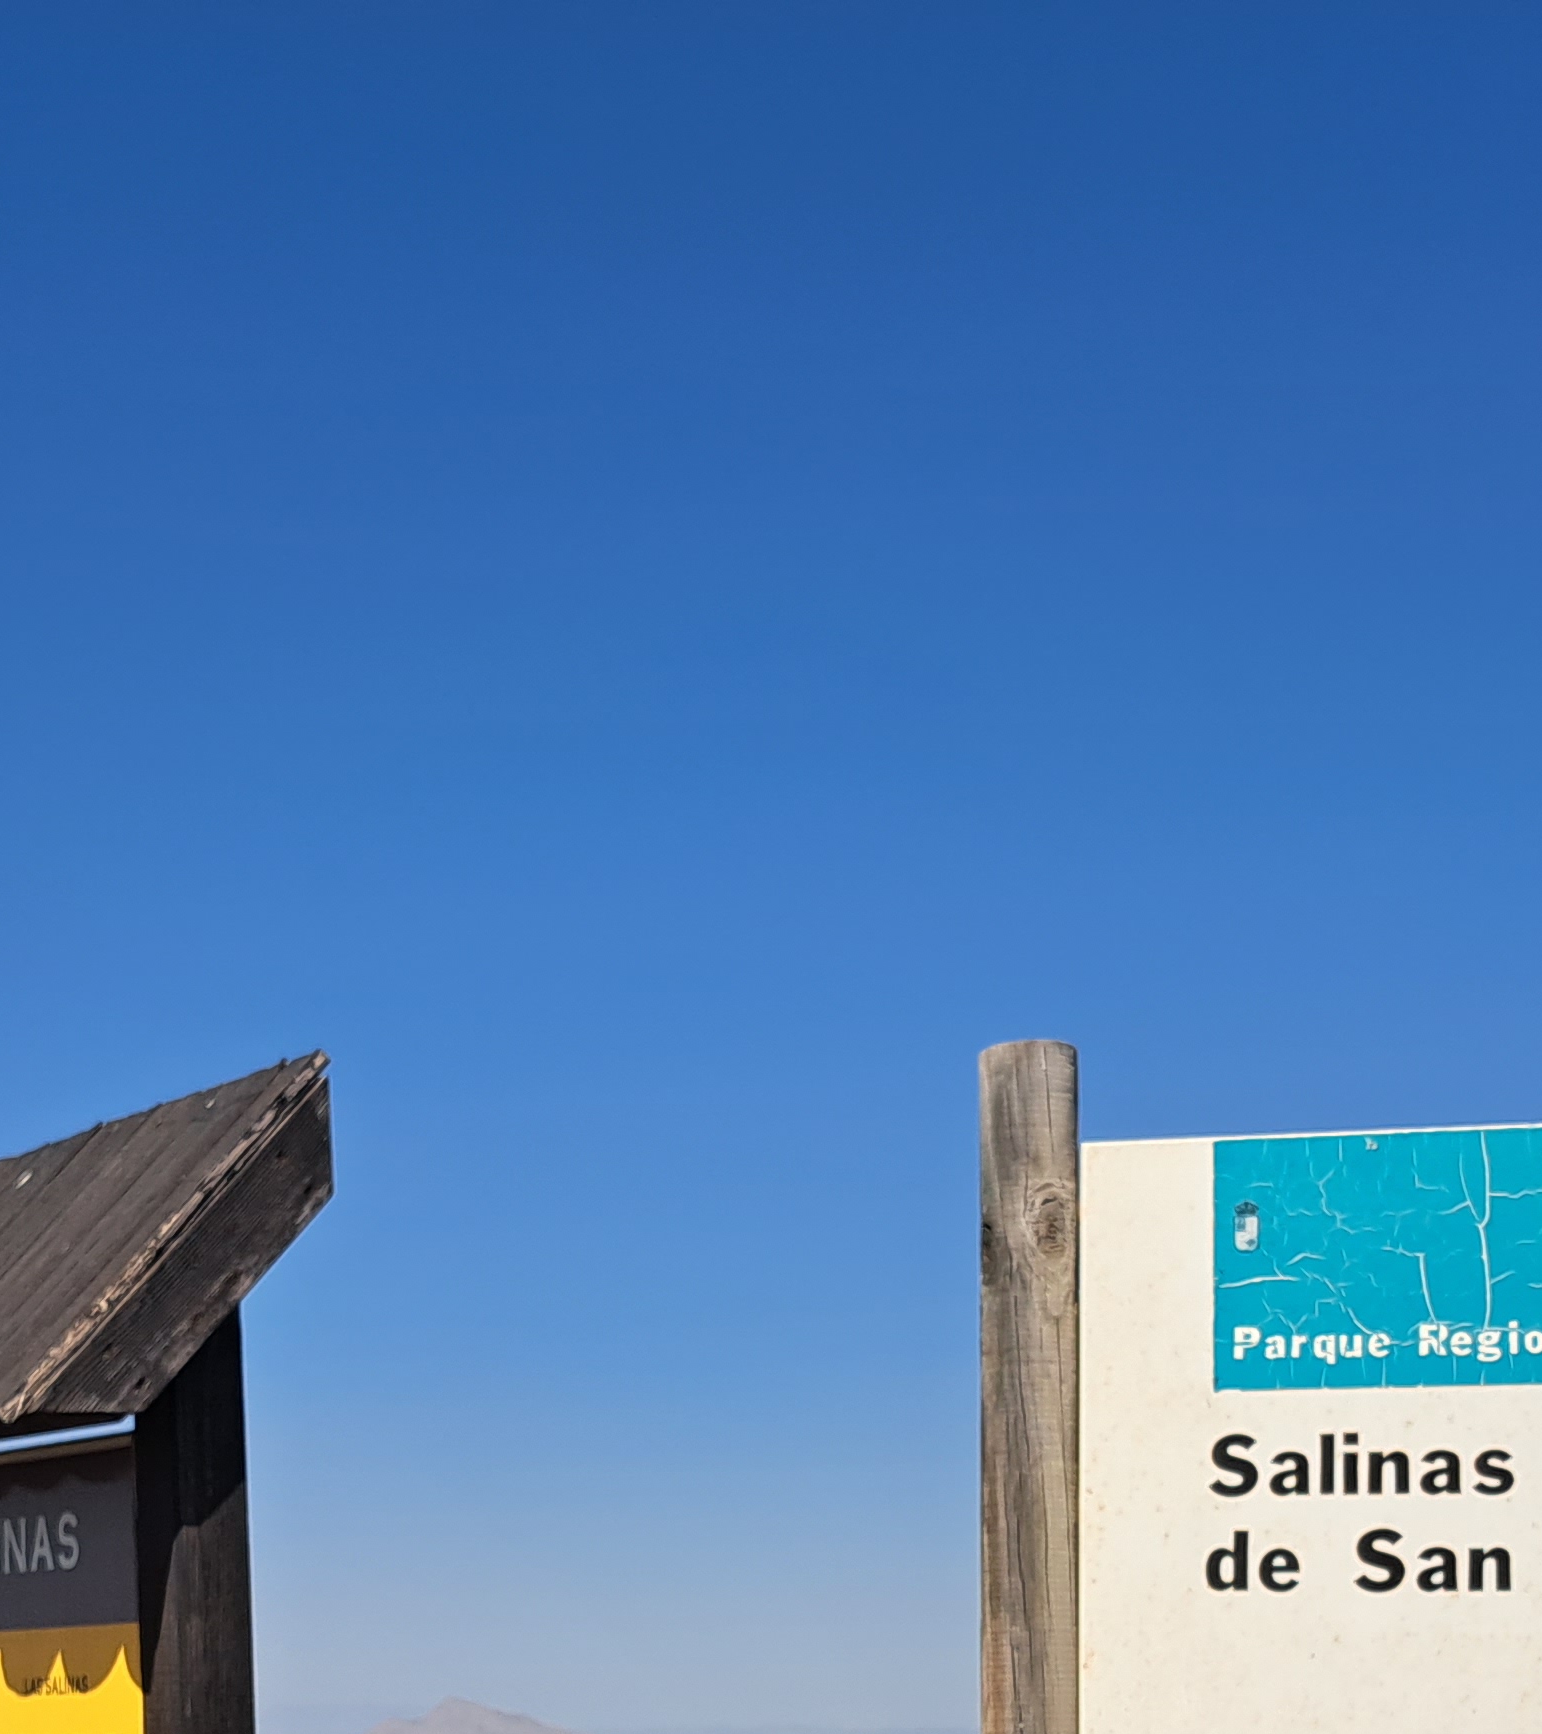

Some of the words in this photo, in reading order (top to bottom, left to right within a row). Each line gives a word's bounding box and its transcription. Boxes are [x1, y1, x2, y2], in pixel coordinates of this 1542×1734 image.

[1233, 1326, 1391, 1366] Parque
[1210, 1432, 1516, 1499] Salinas
[1206, 1530, 1302, 1594] de
[1355, 1528, 1513, 1594] San
